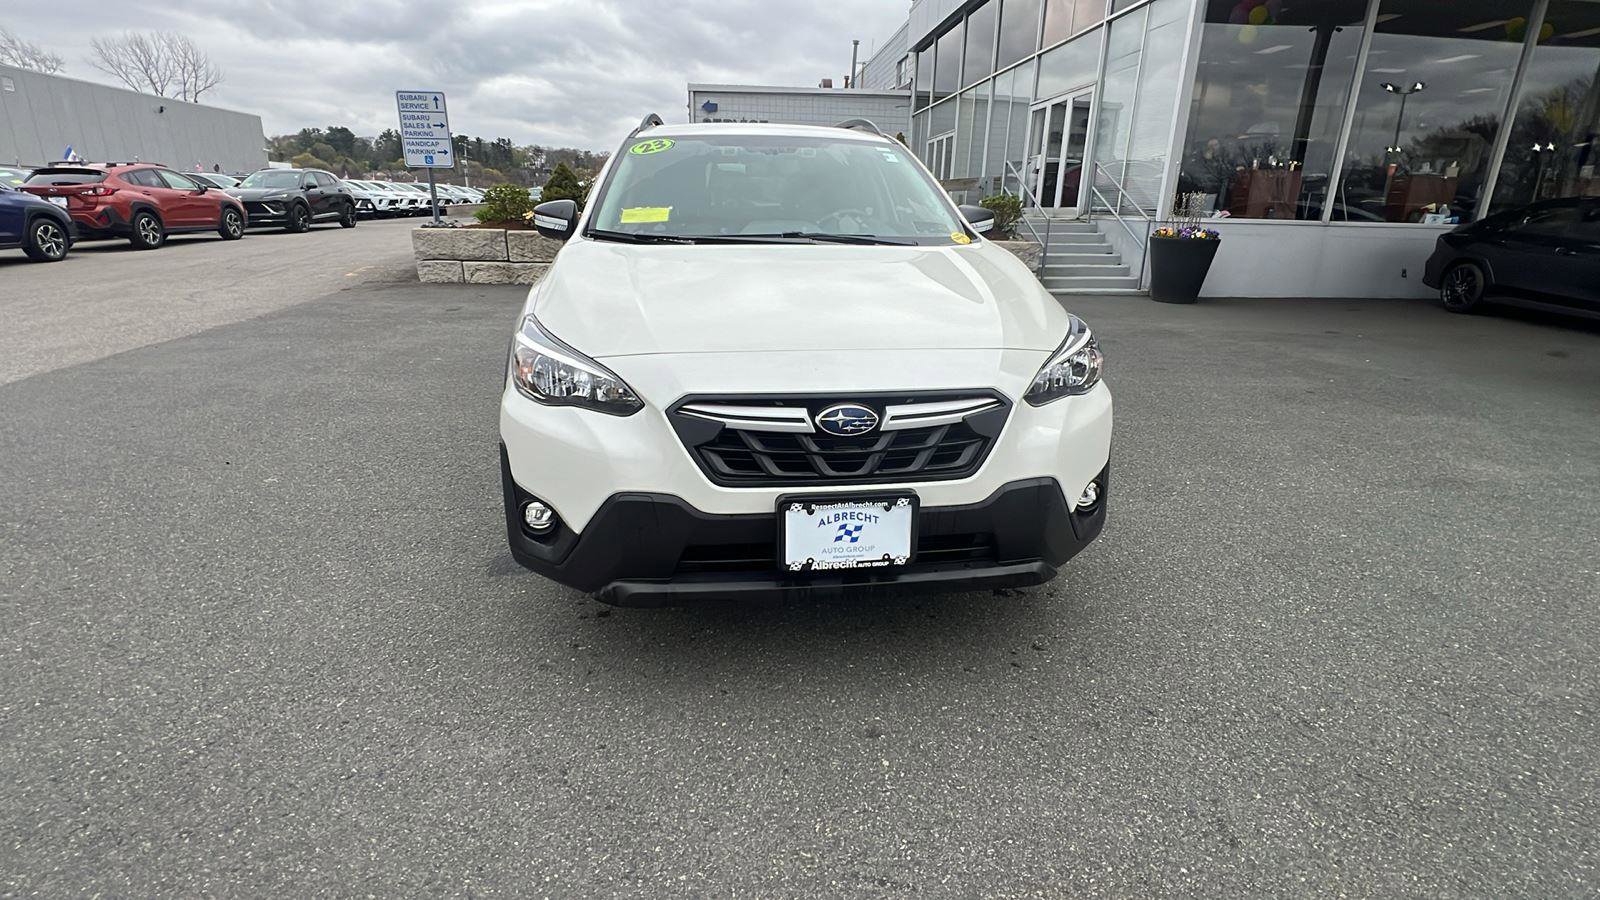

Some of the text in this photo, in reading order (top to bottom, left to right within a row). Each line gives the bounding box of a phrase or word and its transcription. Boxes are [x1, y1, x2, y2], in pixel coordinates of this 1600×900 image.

[401, 102, 429, 110] SERVICE
[639, 140, 666, 153] 23
[811, 501, 888, 510] RespectAtAlbrecht.com
[818, 511, 880, 528] ALBRECHT
[846, 545, 876, 553] GROUP
[811, 559, 857, 571] Albrecht
